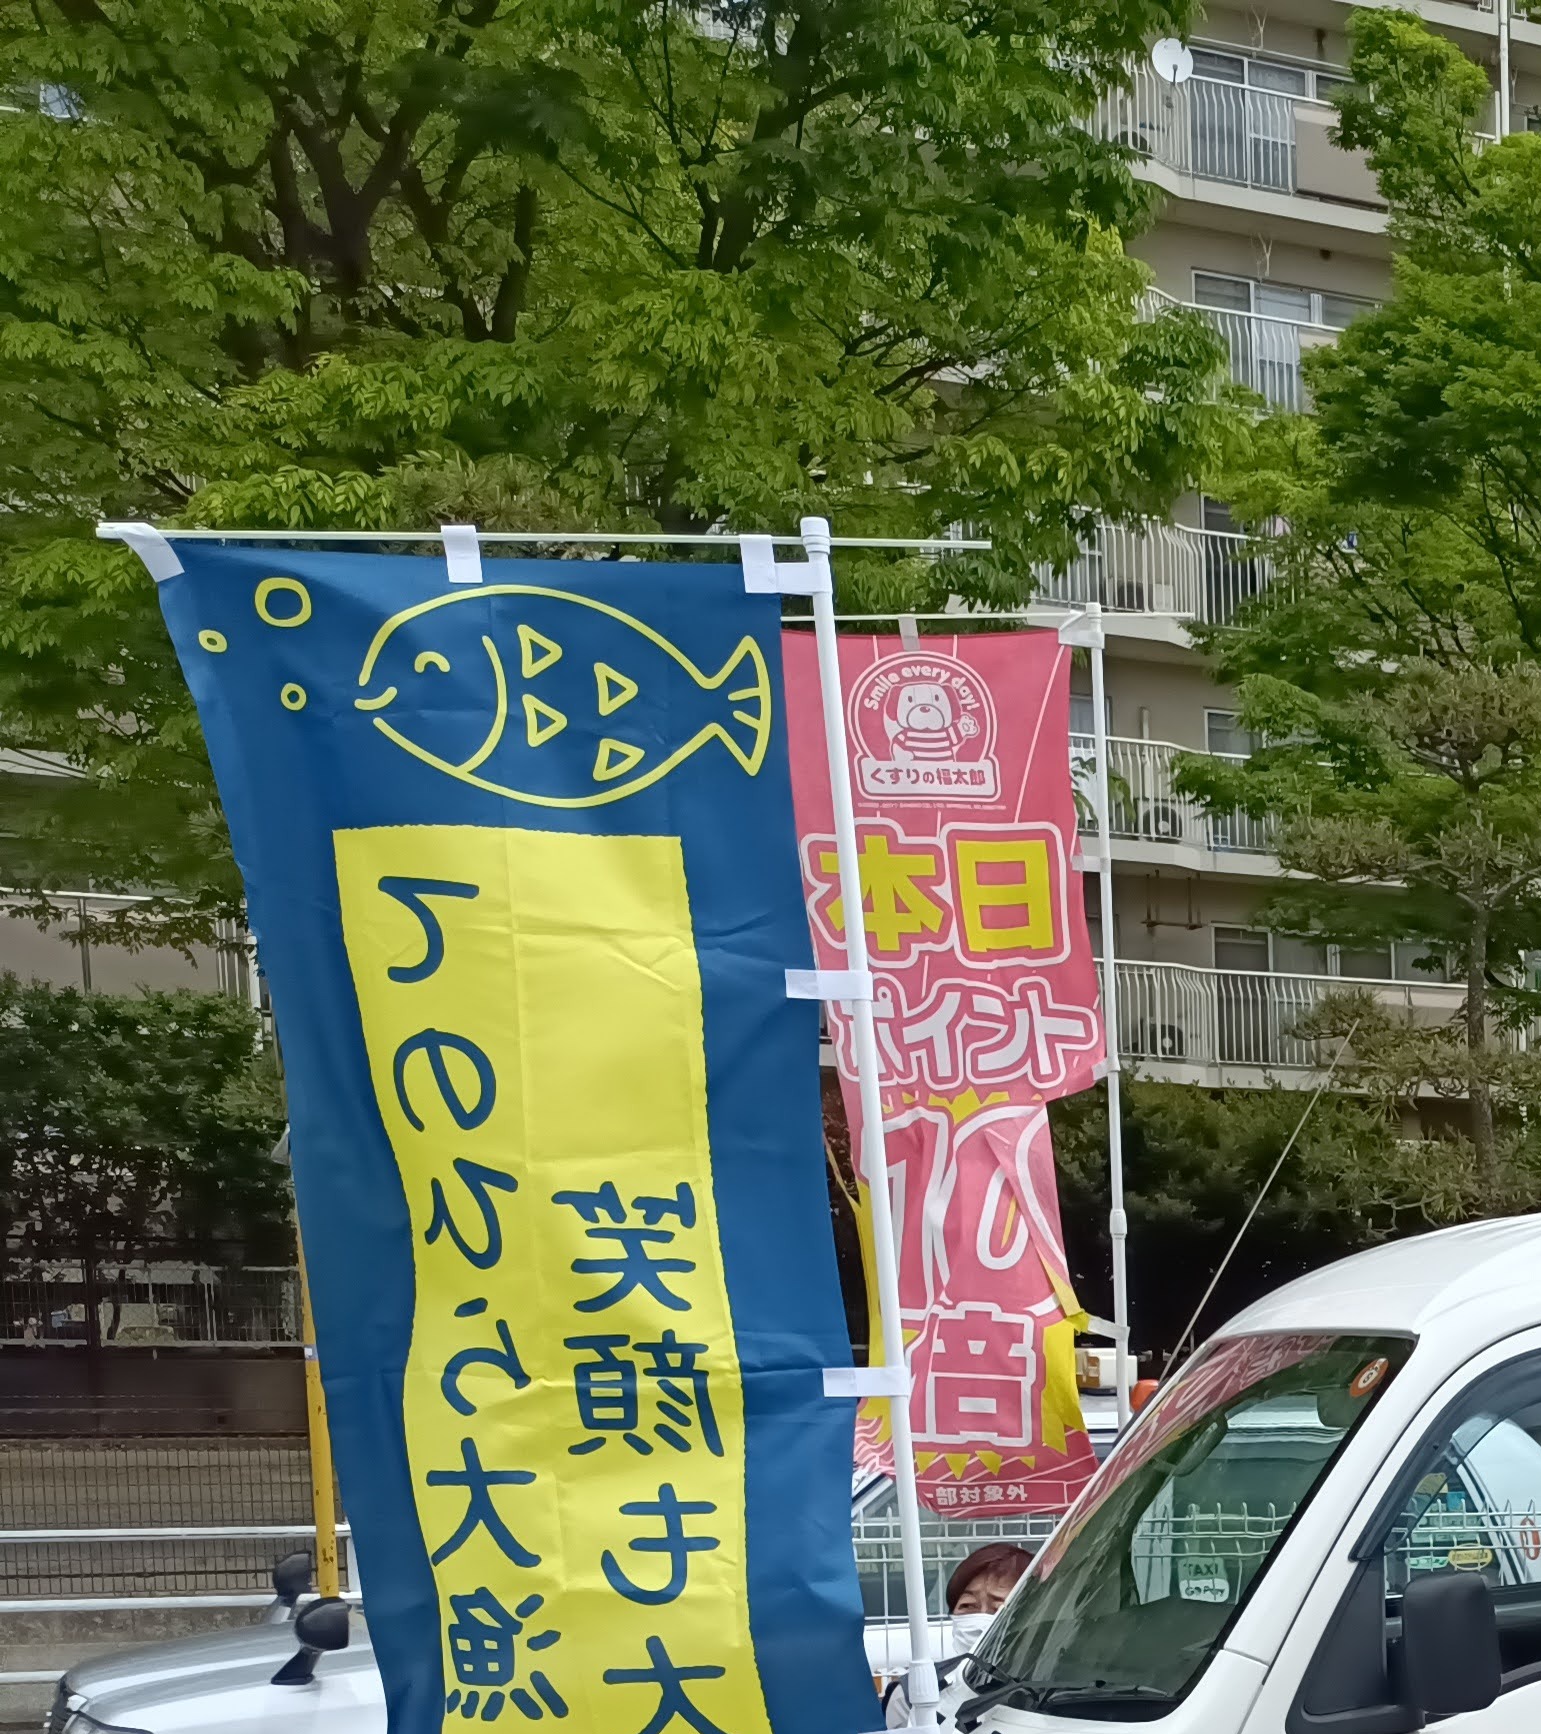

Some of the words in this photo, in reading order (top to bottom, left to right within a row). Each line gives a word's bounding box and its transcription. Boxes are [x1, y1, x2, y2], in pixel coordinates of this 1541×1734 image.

[864, 673, 900, 710] Smile
[902, 665, 950, 683] every
[952, 677, 980, 710] day!
[870, 768, 986, 786] くすりの福太郎
[816, 834, 1053, 955] 本日
[838, 980, 1092, 1084] ポイント
